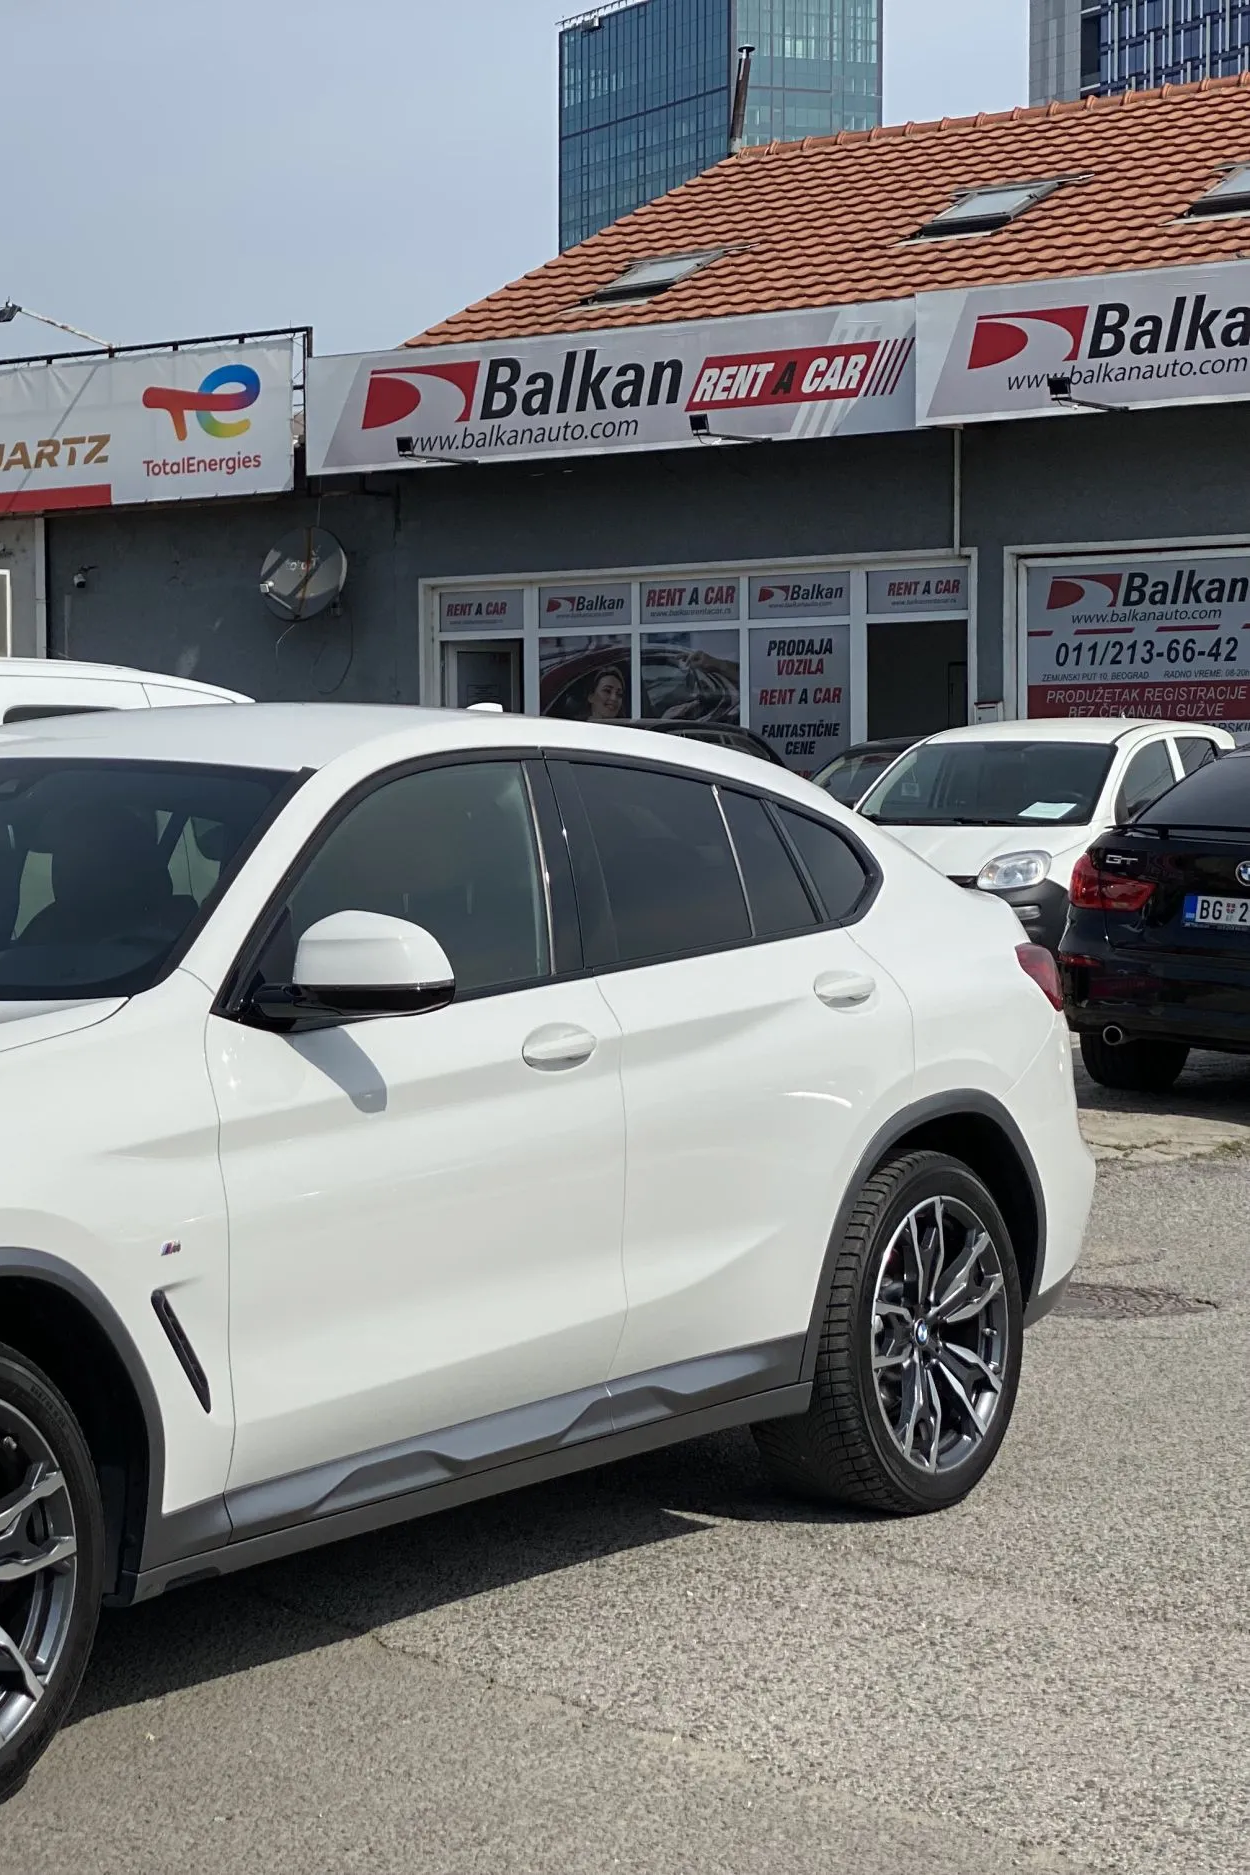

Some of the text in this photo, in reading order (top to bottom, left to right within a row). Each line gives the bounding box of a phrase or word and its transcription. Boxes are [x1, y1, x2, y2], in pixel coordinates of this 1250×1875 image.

[480, 348, 683, 420] Balkan
[694, 354, 868, 403] RENT A CAR
[143, 452, 262, 478] TotalEnergies
[646, 585, 736, 607] RENT A CAR
[790, 584, 843, 600] Balkan
[887, 579, 960, 596] RENT A CAR
[1122, 569, 1249, 607] Balkan
[446, 601, 507, 617] RENT A CAR
[576, 595, 625, 611] Balkan
[1072, 609, 1222, 624] www.balkanauto.com
[767, 638, 833, 656] PRODAJA
[1055, 637, 1239, 666] 011/213-66-42
[777, 658, 824, 676] VOZILA
[1042, 673, 1080, 682] ZEMUNSKI
[1082, 672, 1097, 681] PUT
[1164, 670, 1192, 678] RADNO
[759, 687, 842, 705] RENT A CAR
[1046, 685, 1248, 704] PRODUŽETAK REGISTRACIJE
[1100, 703, 1163, 718] ČEKANJA
[1176, 702, 1225, 717] GUŽVE
[762, 719, 840, 738] FANTASTIČNE
[785, 741, 816, 755] CENE
[1105, 854, 1139, 865] GT
[1199, 899, 1223, 920] BG
